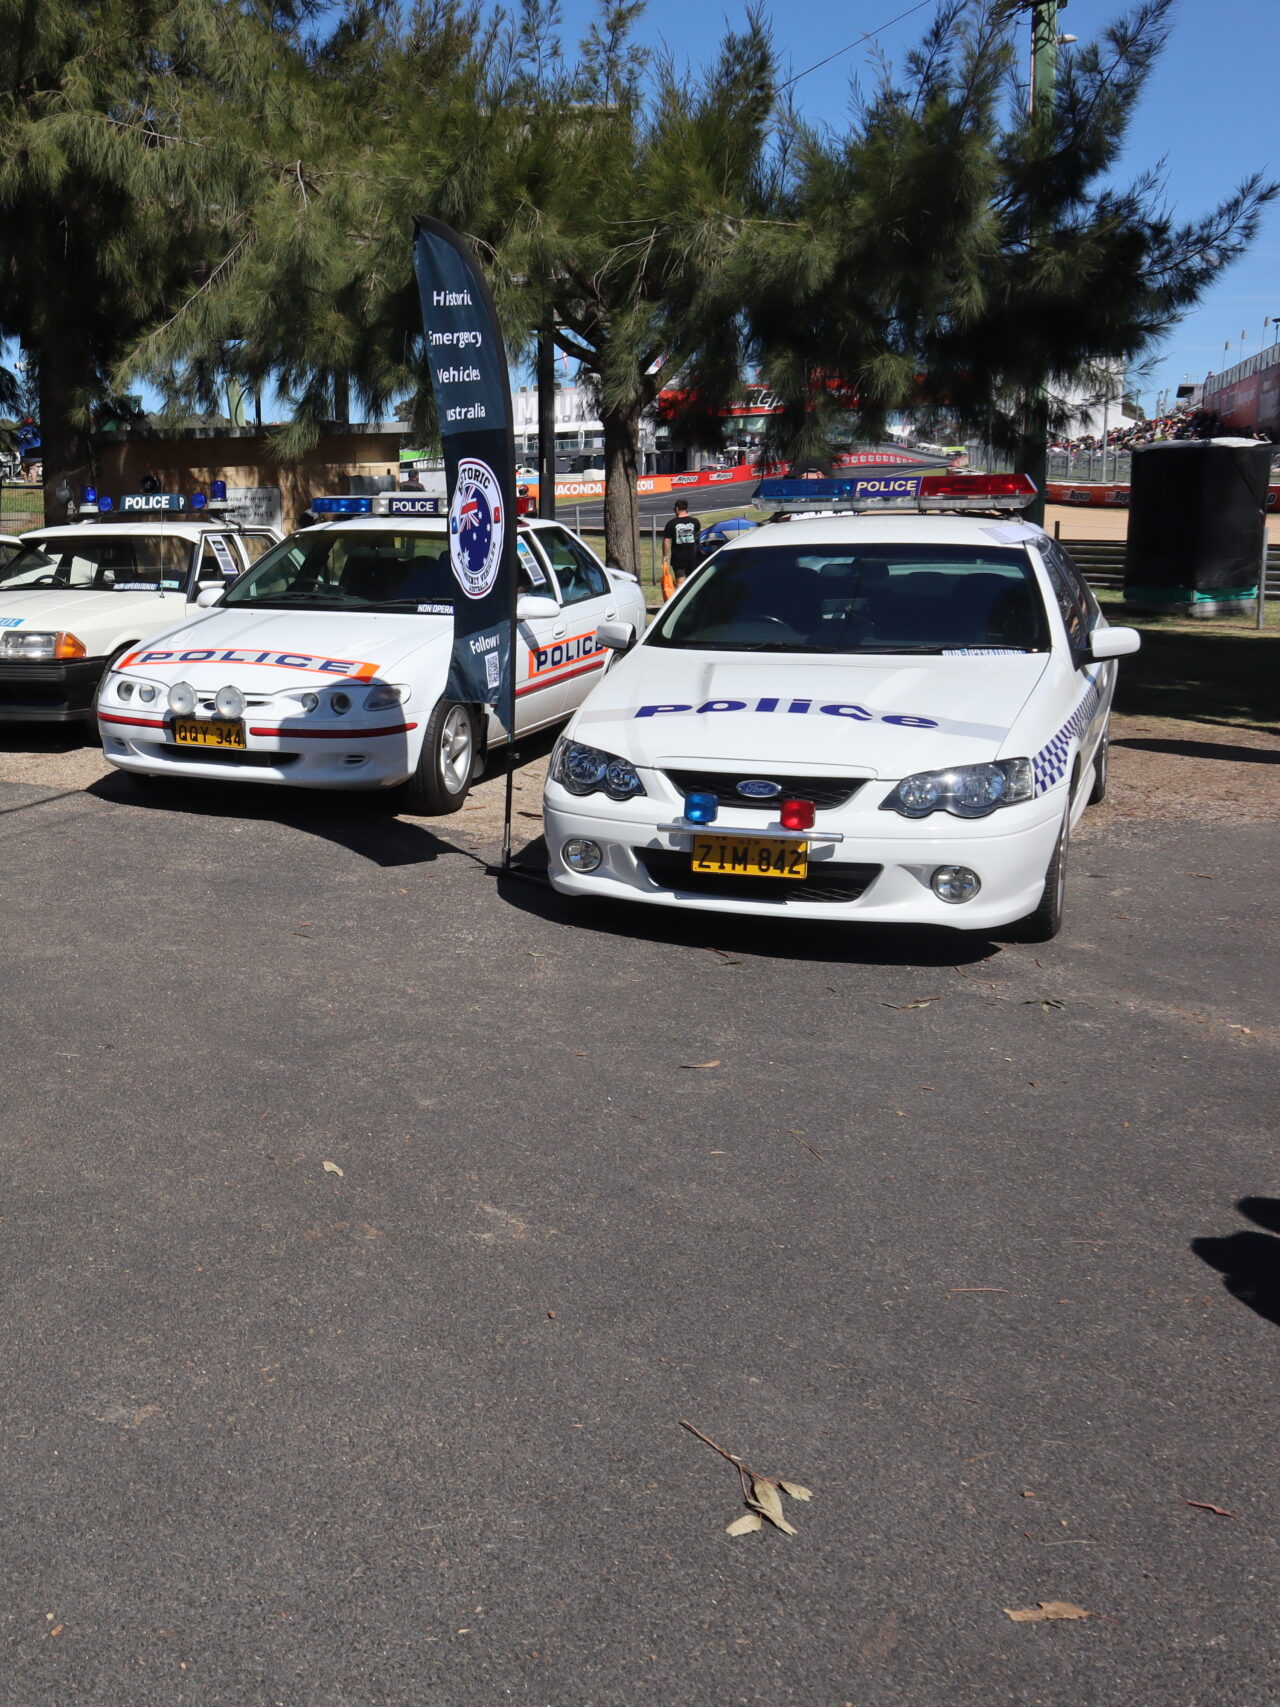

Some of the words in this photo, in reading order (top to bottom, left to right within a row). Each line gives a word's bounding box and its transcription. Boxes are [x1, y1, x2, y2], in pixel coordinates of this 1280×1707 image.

[437, 366, 480, 383] Vehicles
[446, 402, 486, 421] ustralia
[856, 480, 917, 492] POLICE
[125, 496, 169, 509] POLICE
[392, 501, 434, 511] POLICE
[417, 604, 430, 613] NON
[432, 605, 454, 614] OPERA
[469, 635, 496, 655] Follow
[537, 636, 603, 672] POLICE
[140, 650, 354, 673] POLICE
[634, 698, 939, 728] police
[179, 725, 208, 743] QQY
[216, 727, 240, 746] 344
[698, 844, 748, 871] ZIM
[758, 847, 801, 875] 842
